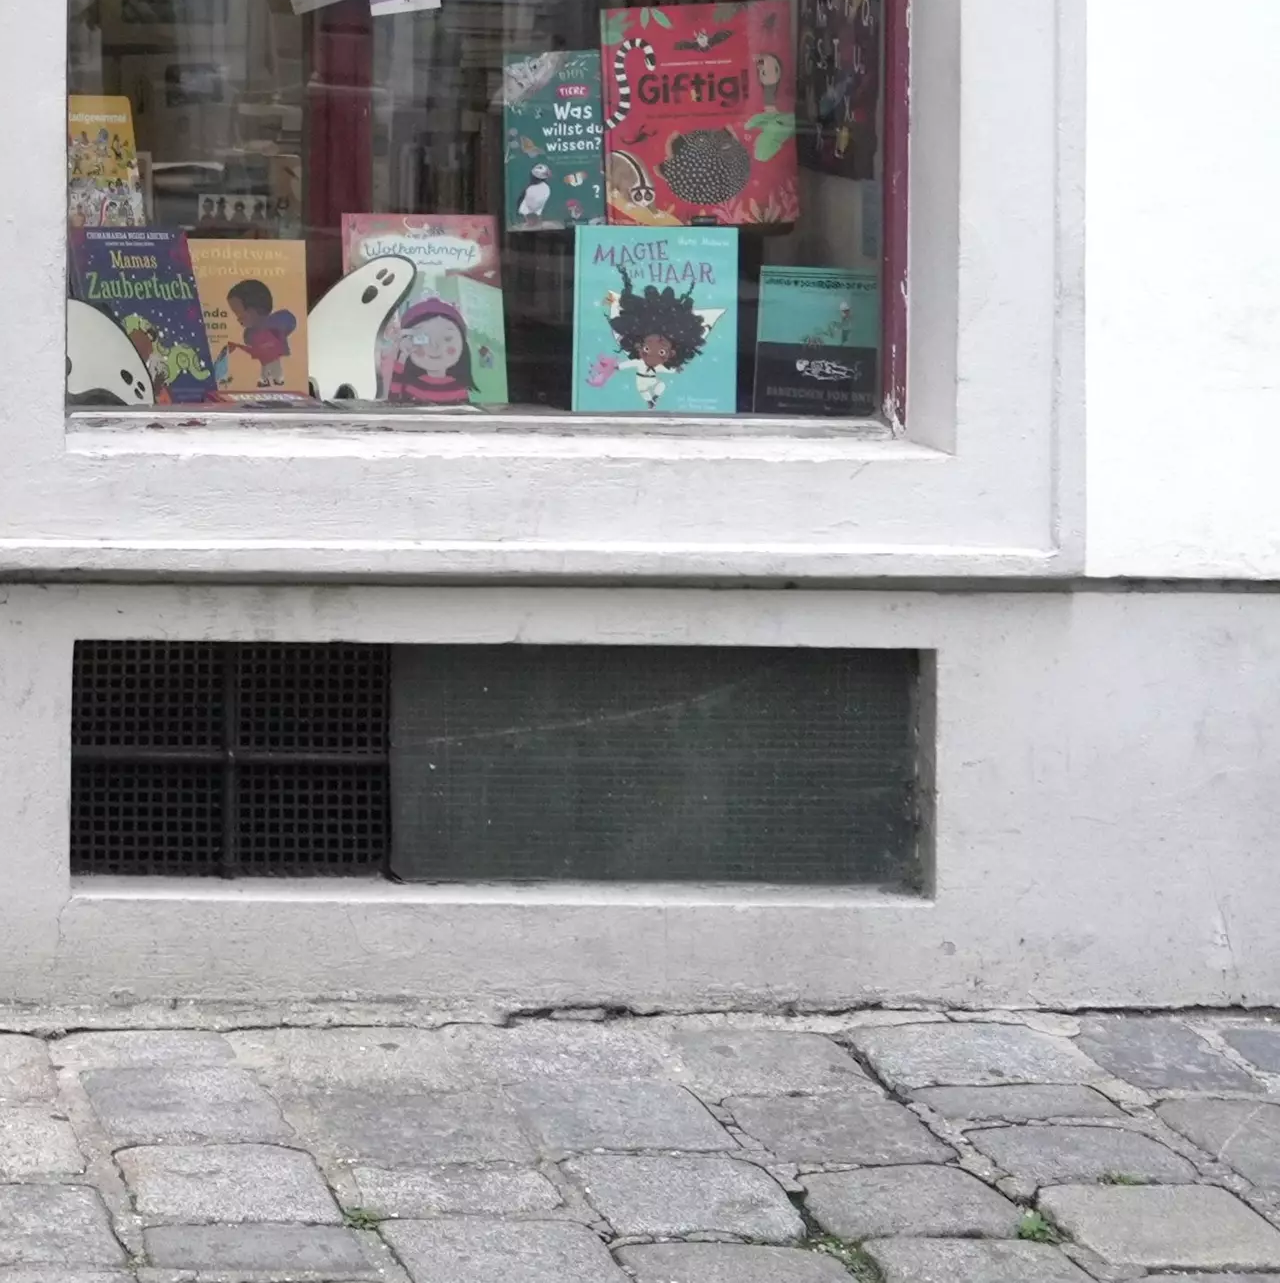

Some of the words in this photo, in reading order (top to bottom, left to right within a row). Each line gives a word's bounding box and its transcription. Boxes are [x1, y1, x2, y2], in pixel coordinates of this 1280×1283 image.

[558, 85, 588, 96] TIERE
[637, 69, 749, 109] Giftig!
[553, 101, 593, 120] Was
[542, 122, 583, 136] willst
[586, 123, 604, 134] du
[546, 138, 602, 152] wissen?
[109, 250, 158, 269] Mamas
[593, 239, 670, 267] MAGIE
[628, 268, 646, 280] IM
[648, 262, 717, 285] HAAR
[85, 271, 194, 301] Zaubertuch
[203, 308, 228, 318] nda
